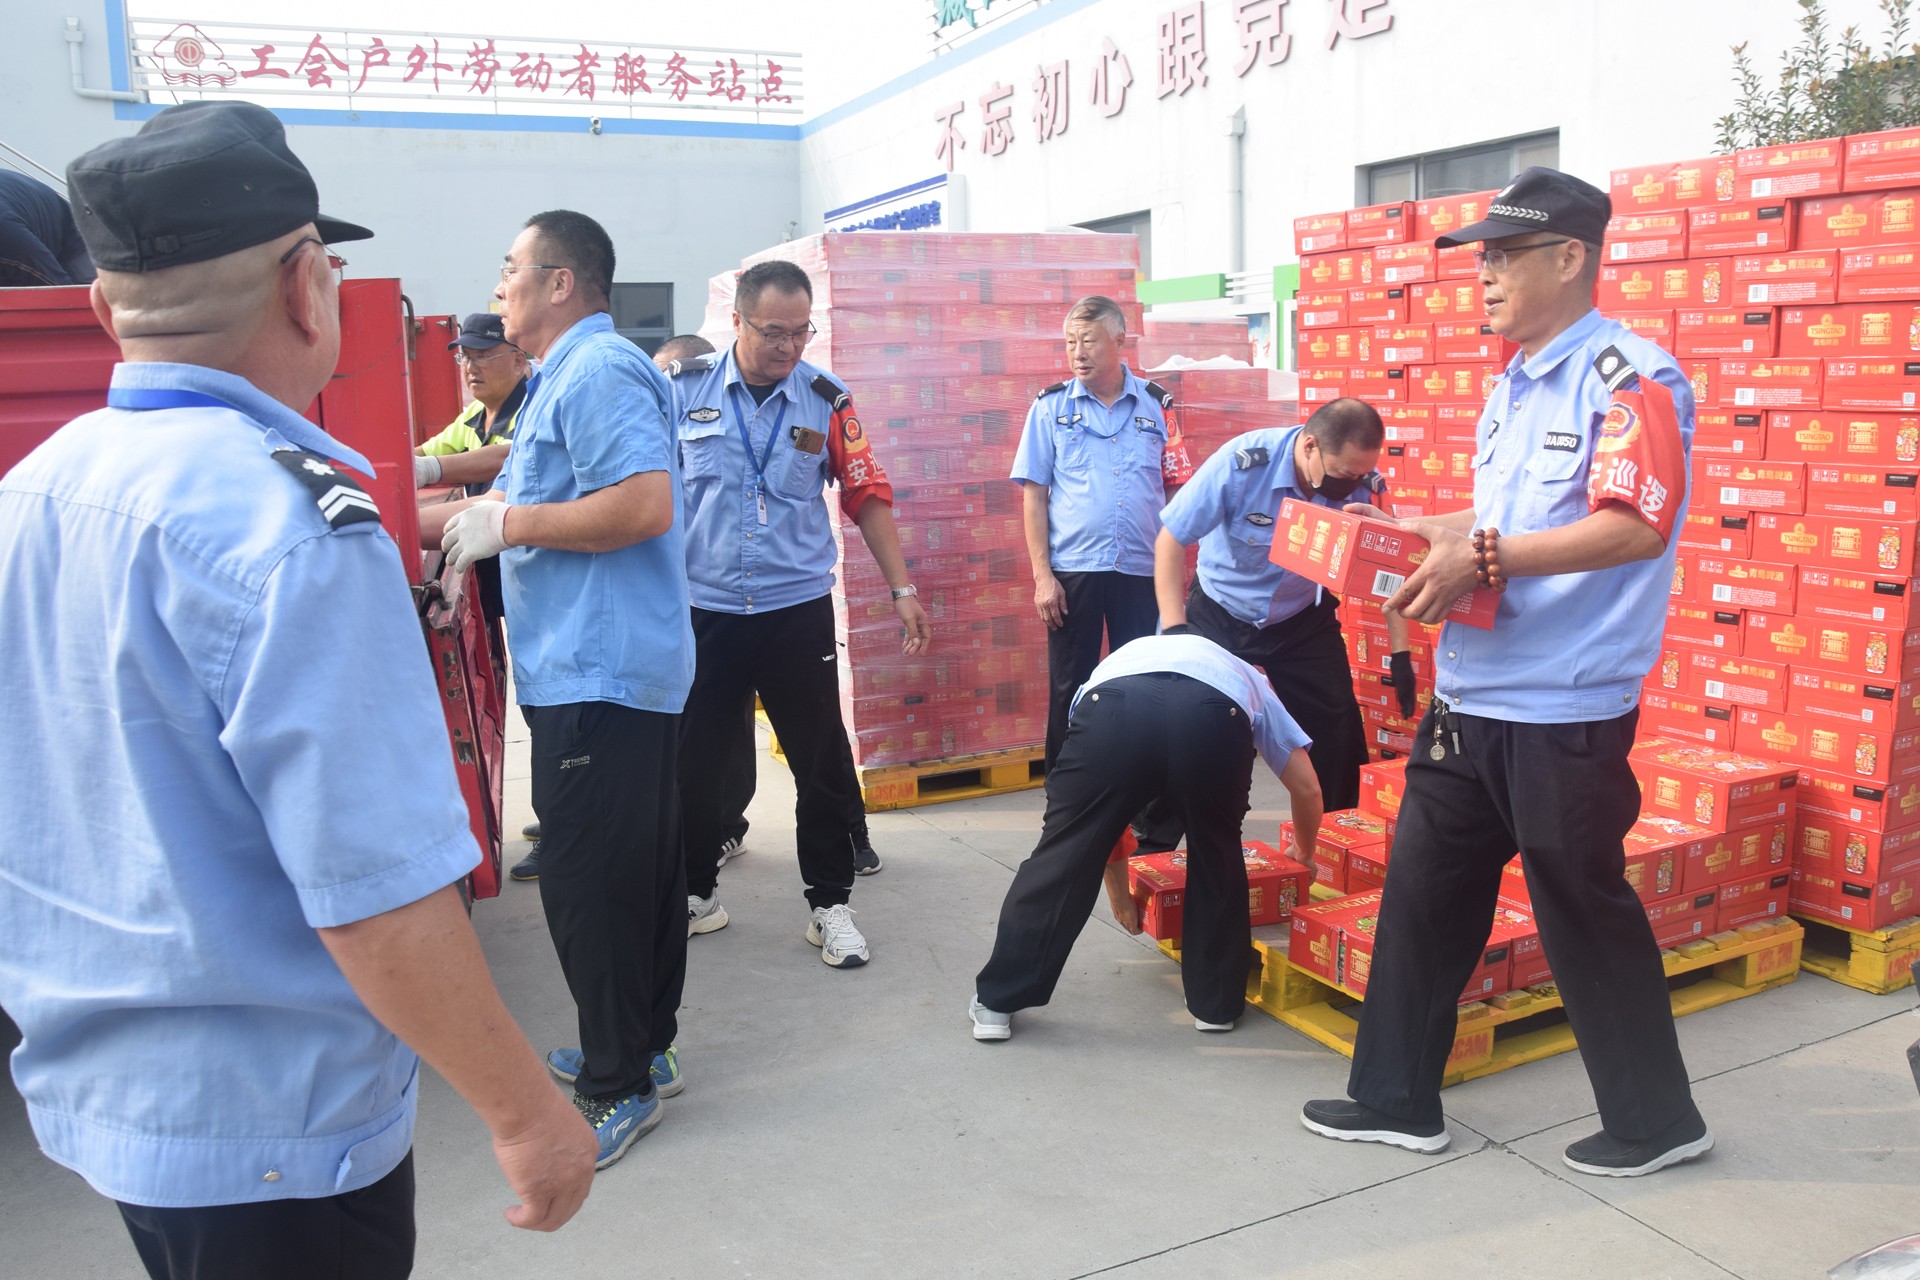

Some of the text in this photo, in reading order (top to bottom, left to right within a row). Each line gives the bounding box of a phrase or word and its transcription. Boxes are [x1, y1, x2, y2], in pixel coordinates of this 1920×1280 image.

[240, 33, 793, 105] 工会户外劳动者服务站点
[1306, 894, 1381, 915] TSINGTAO
